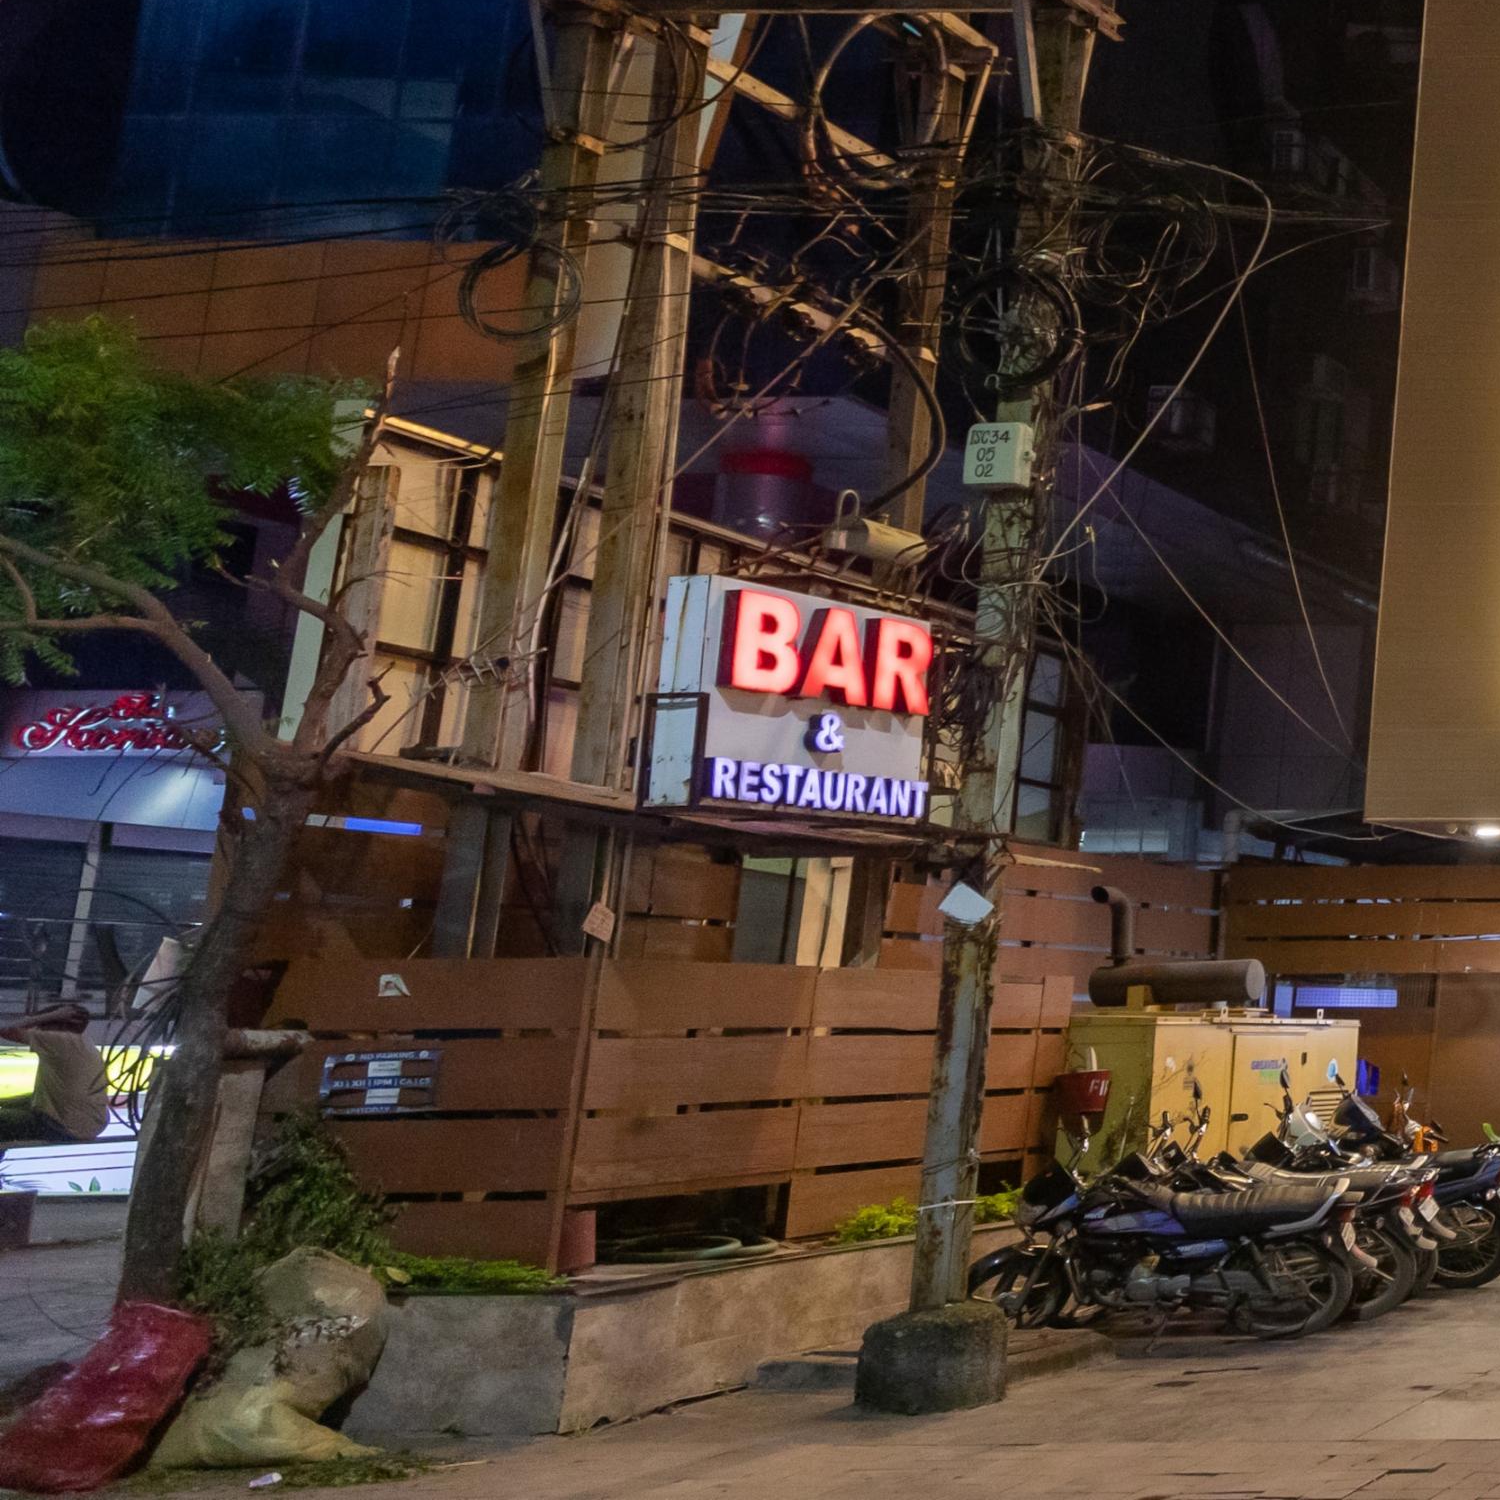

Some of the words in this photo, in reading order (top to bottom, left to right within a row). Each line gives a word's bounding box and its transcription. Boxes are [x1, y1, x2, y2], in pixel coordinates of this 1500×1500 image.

[975, 463, 994, 478] 02
[976, 447, 996, 462] 05
[729, 588, 934, 717] BAR
[814, 712, 846, 752] &
[711, 756, 930, 819] RESTAURANT
